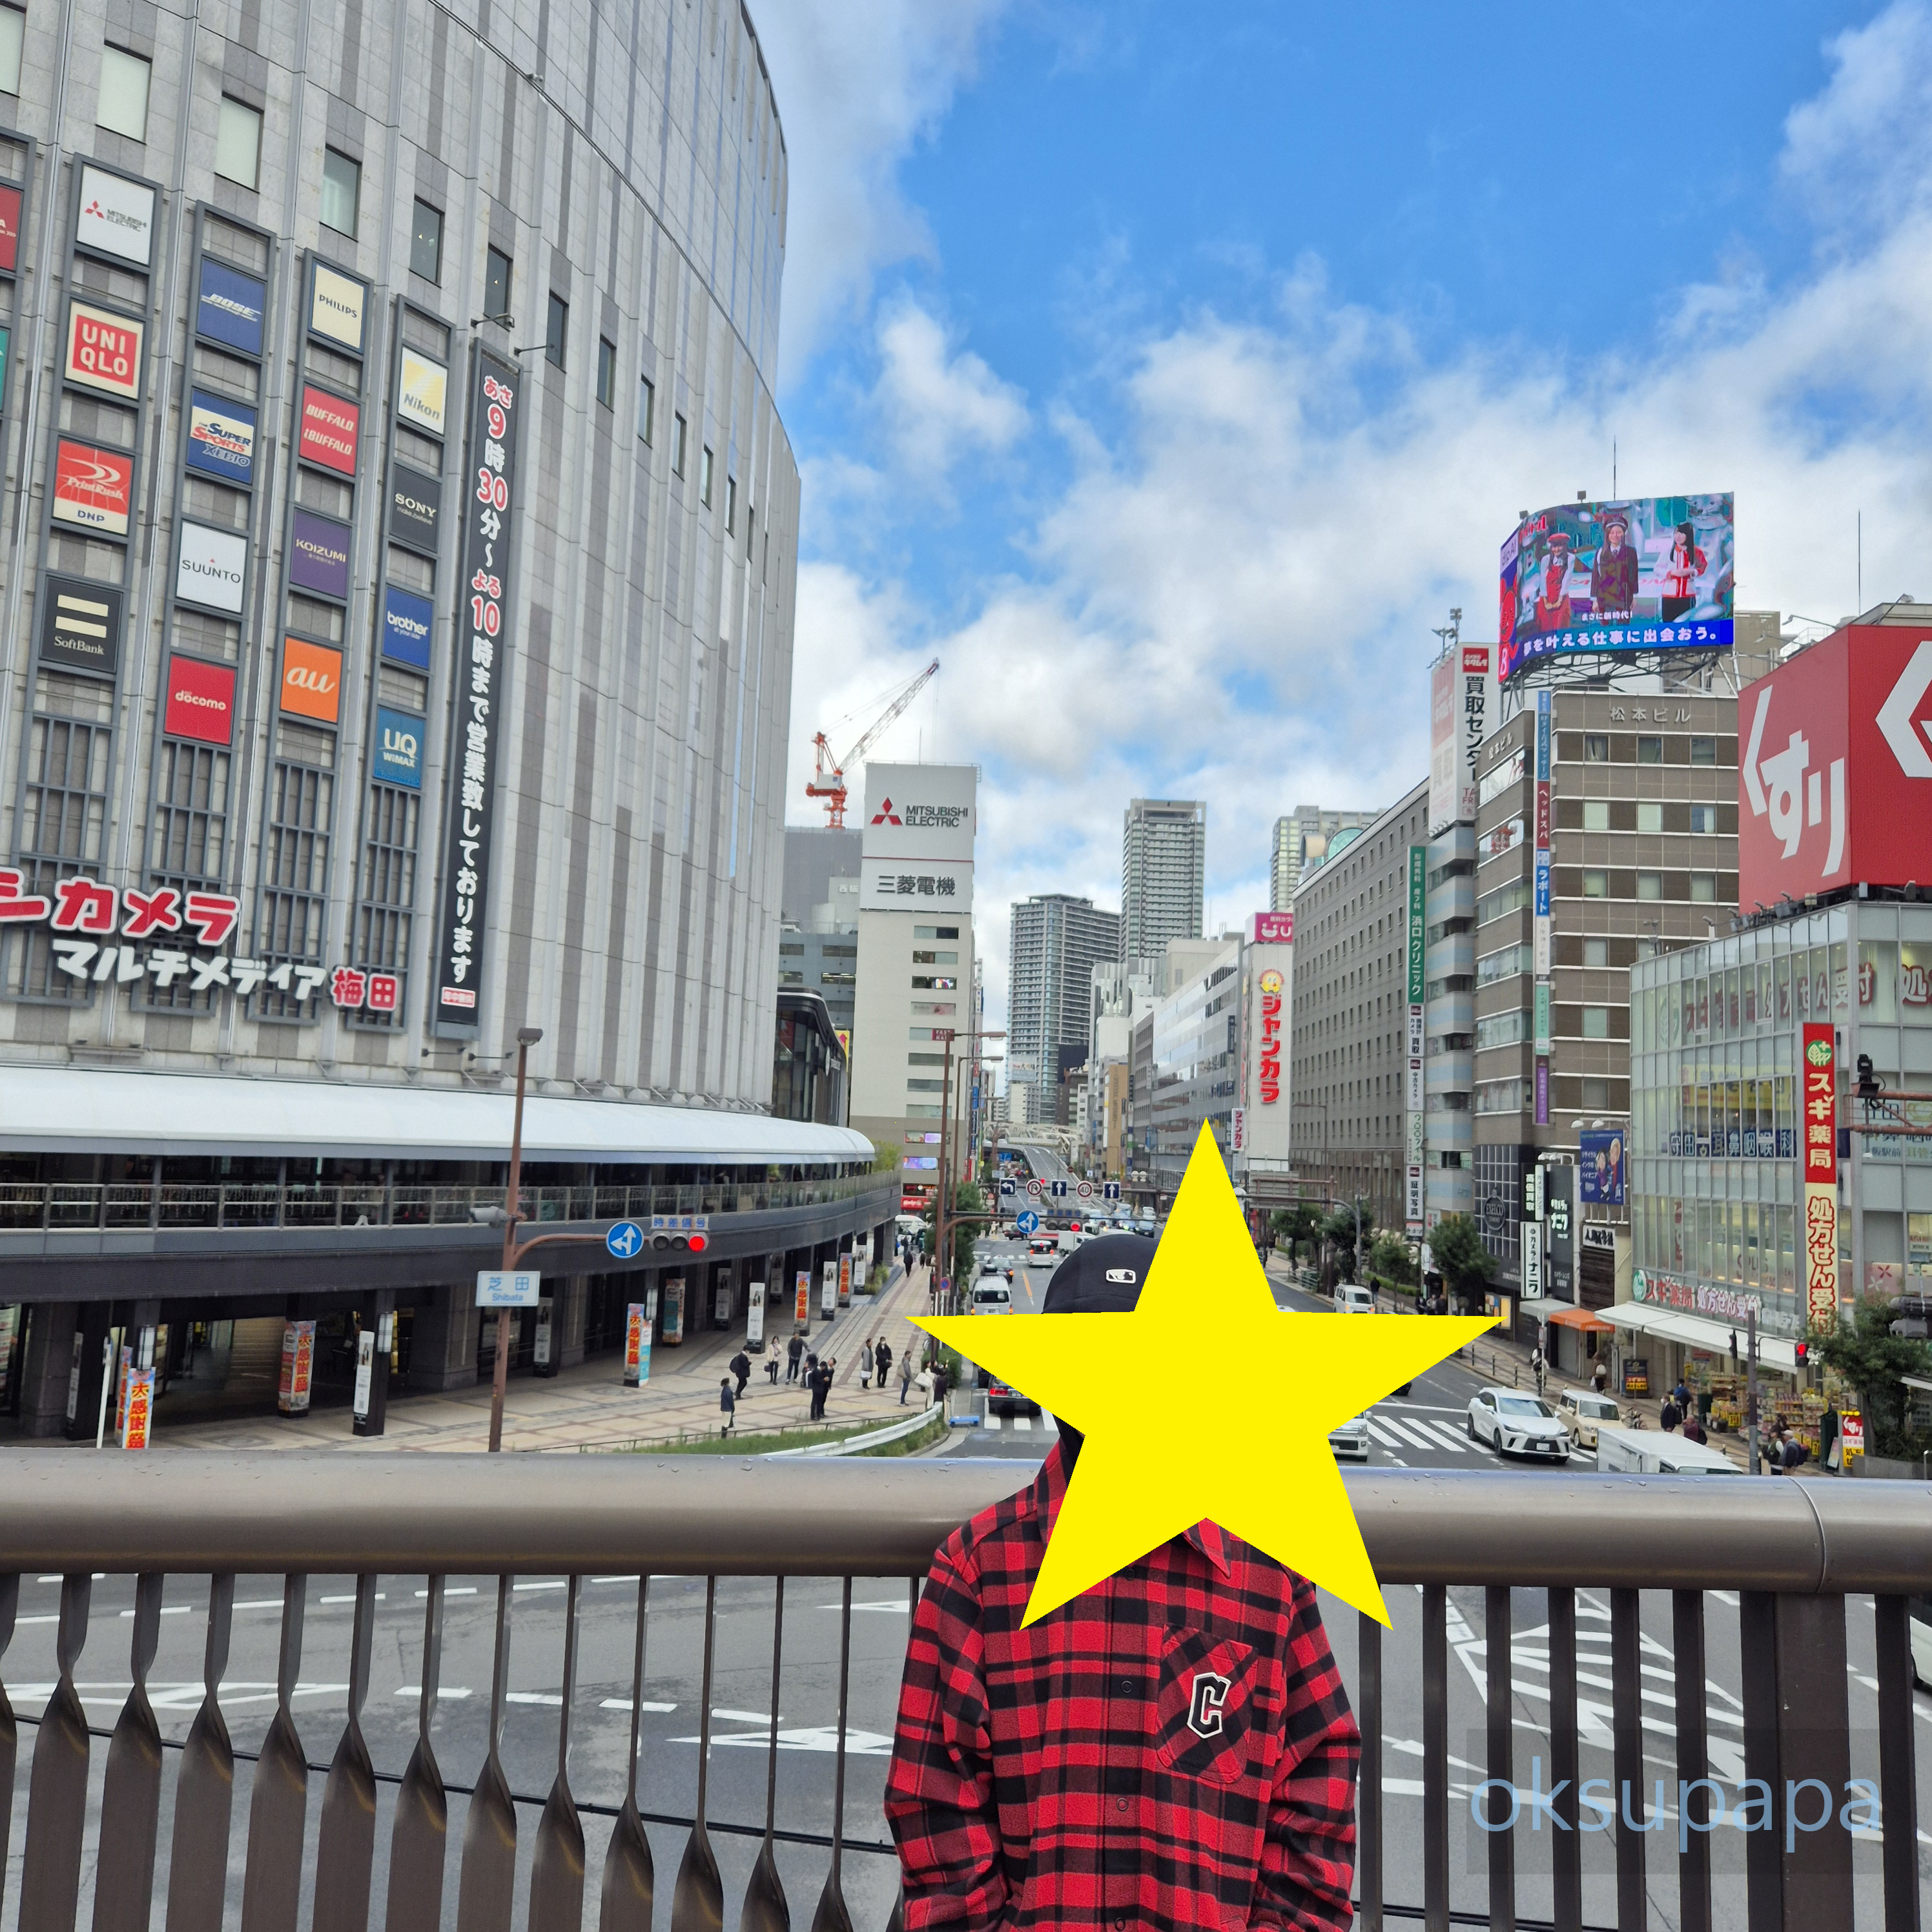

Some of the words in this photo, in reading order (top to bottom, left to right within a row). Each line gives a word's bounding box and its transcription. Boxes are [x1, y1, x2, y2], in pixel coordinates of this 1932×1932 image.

[107, 209, 147, 227] MITSUBISHI
[107, 215, 141, 232] ELECTRIC
[209, 294, 261, 318] BOSE
[319, 294, 357, 318] PHILIPS
[81, 323, 125, 354] UNI
[80, 347, 128, 376] QLO
[305, 404, 354, 431] BUFFALO
[404, 393, 440, 420] Nikon
[192, 426, 245, 453] SPORTS
[207, 422, 251, 446] SUPER
[202, 443, 251, 467] XEBIO
[67, 477, 123, 500] PrintRush
[77, 509, 105, 522] DNP
[395, 493, 437, 518] SONY
[296, 539, 346, 562] KOIZUMI
[181, 559, 241, 584] SUUNTO
[387, 611, 429, 636] brother
[54, 635, 105, 656] SoftBank
[285, 666, 336, 694] au
[175, 690, 226, 710] docomo
[1610, 707, 1691, 724] 松本ビル
[384, 728, 417, 759] UQ
[1488, 732, 1513, 760] 松本ビル
[1463, 787, 1475, 796] TA
[1742, 684, 1845, 877] くすり
[905, 816, 960, 827] ELECTRIC
[906, 805, 969, 817] MITSUBISHI
[1539, 789, 1548, 839] ヘッドスパ
[876, 874, 956, 896] 三菱電機
[1537, 869, 1548, 914] ラポート
[1411, 916, 1423, 995] 浜口クリニック
[52, 939, 327, 1000] マルチメディア
[331, 967, 398, 1011] 梅田
[1902, 965, 1932, 1005] 処
[1259, 993, 1282, 1104] ジャンカラ
[1411, 1038, 1420, 1054] 買取
[1807, 1072, 1835, 1169] スギ薬局
[1670, 1133, 1695, 1156] 守田
[1712, 1131, 1793, 1157] 耳鼻咽喉科
[1871, 1146, 1902, 1158] 阪駅前
[1907, 1146, 1932, 1158] 耳管
[1410, 1180, 1419, 1216] 証明写真
[1486, 1203, 1504, 1216] EXELCO
[653, 1215, 706, 1228] 時差信号
[1528, 1236, 1538, 1293] カメラのナニワ
[1807, 1196, 1836, 1335] 処方せん受付
[488, 1276, 529, 1291] 芝田
[491, 1293, 524, 1302] Shibata
[1645, 1277, 1695, 1310] スギ薬局
[1697, 1285, 1762, 1323] 処方せん受付
[1843, 1416, 1864, 1436] くすり
[1186, 1672, 1232, 1739] C
